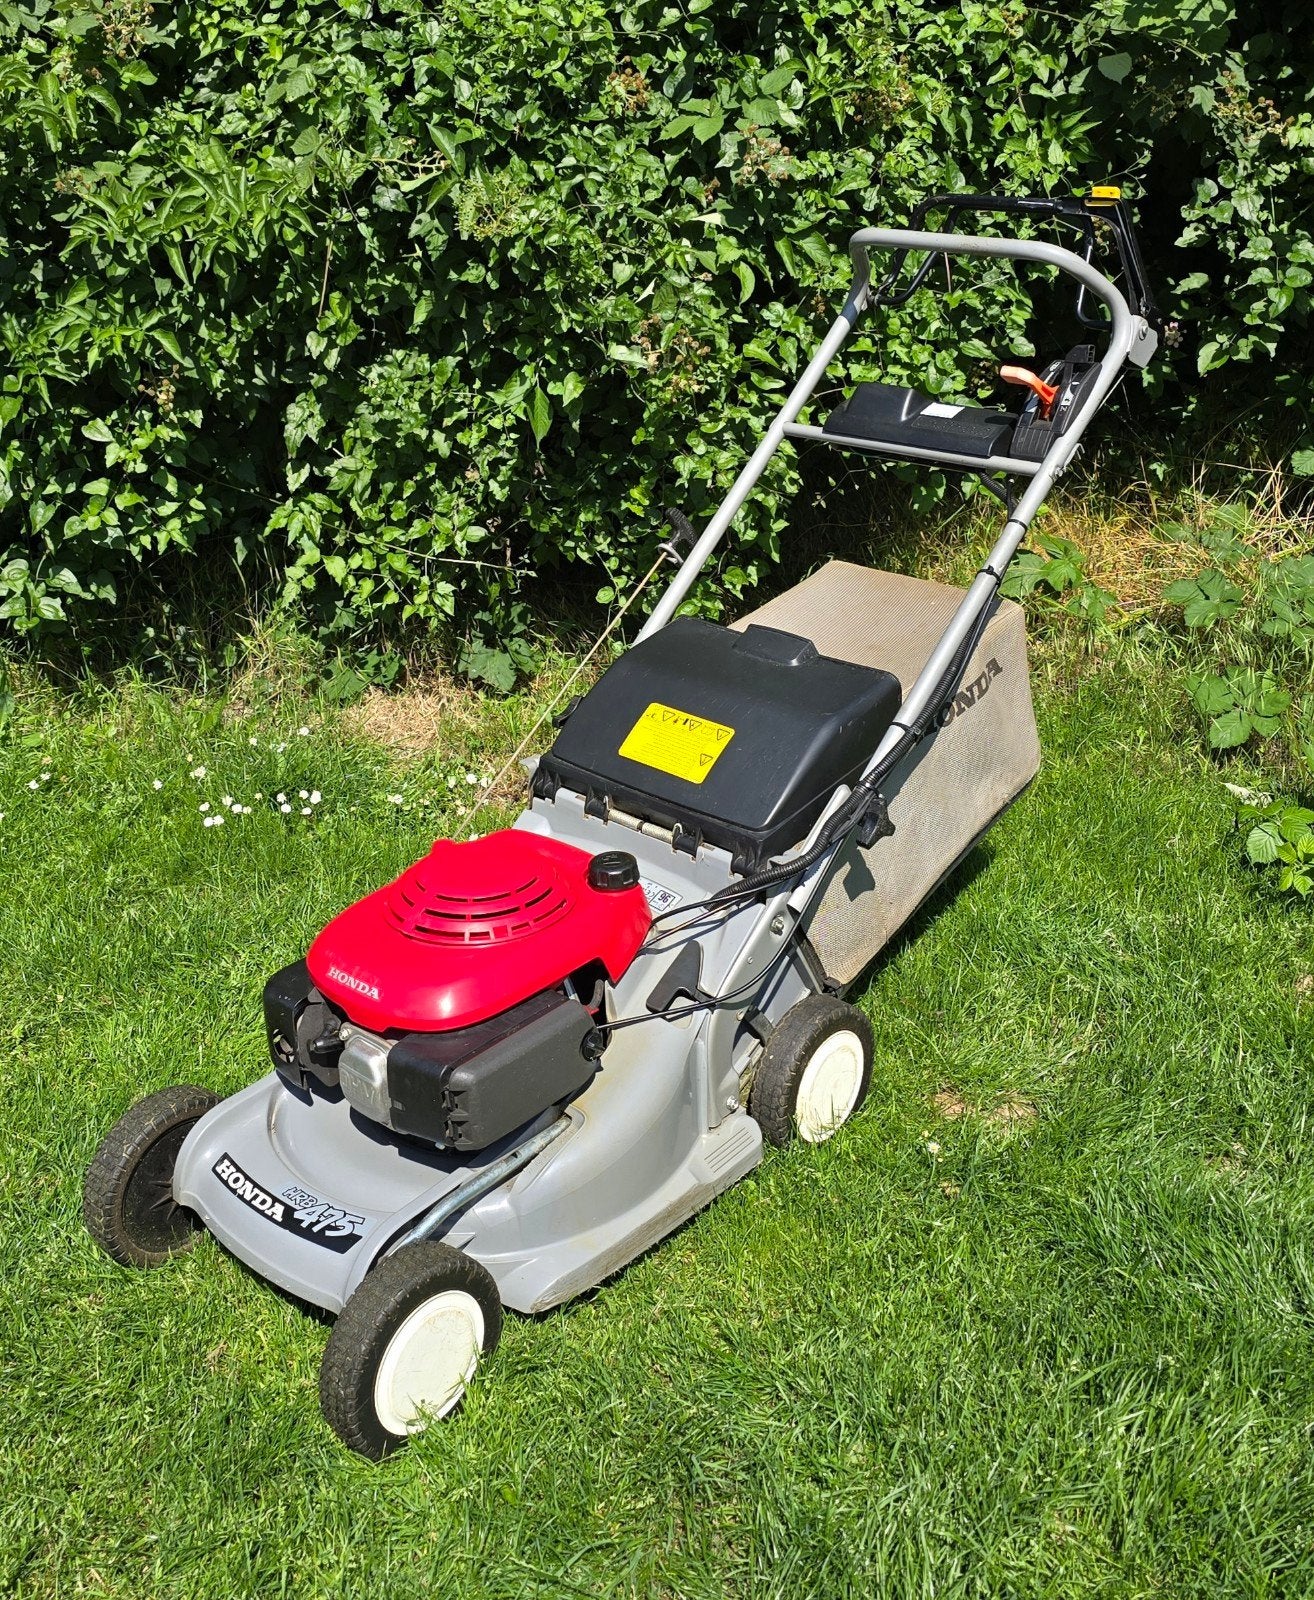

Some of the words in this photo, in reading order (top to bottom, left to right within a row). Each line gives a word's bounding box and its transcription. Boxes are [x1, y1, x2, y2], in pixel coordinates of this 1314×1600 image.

[931, 657, 1003, 732] ONDA
[658, 892, 671, 904] 96
[327, 966, 380, 1000] HONDA
[215, 1158, 285, 1222] HONDA
